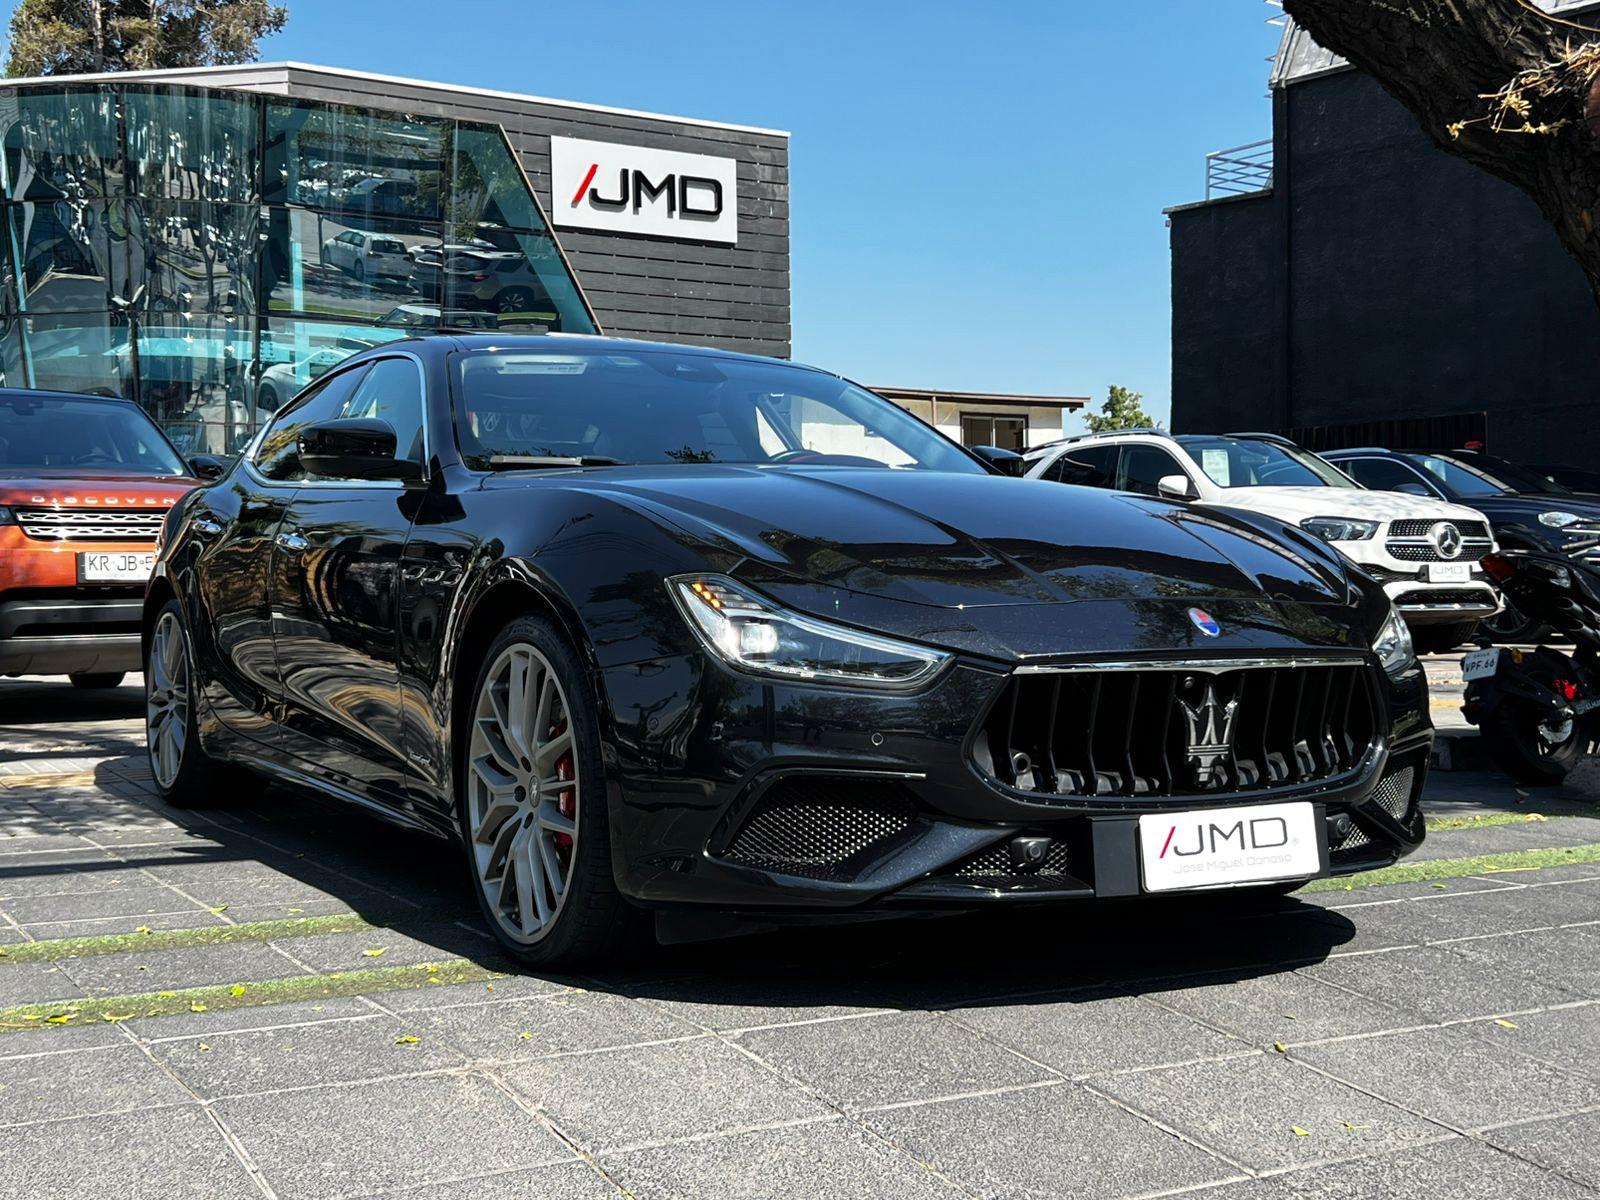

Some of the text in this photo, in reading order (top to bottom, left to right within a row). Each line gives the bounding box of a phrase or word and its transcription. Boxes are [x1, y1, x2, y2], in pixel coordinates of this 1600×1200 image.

[31, 496, 176, 504] DISCOVER
[1206, 857, 1243, 870] Miguel
[1246, 853, 1293, 866] Donoso
